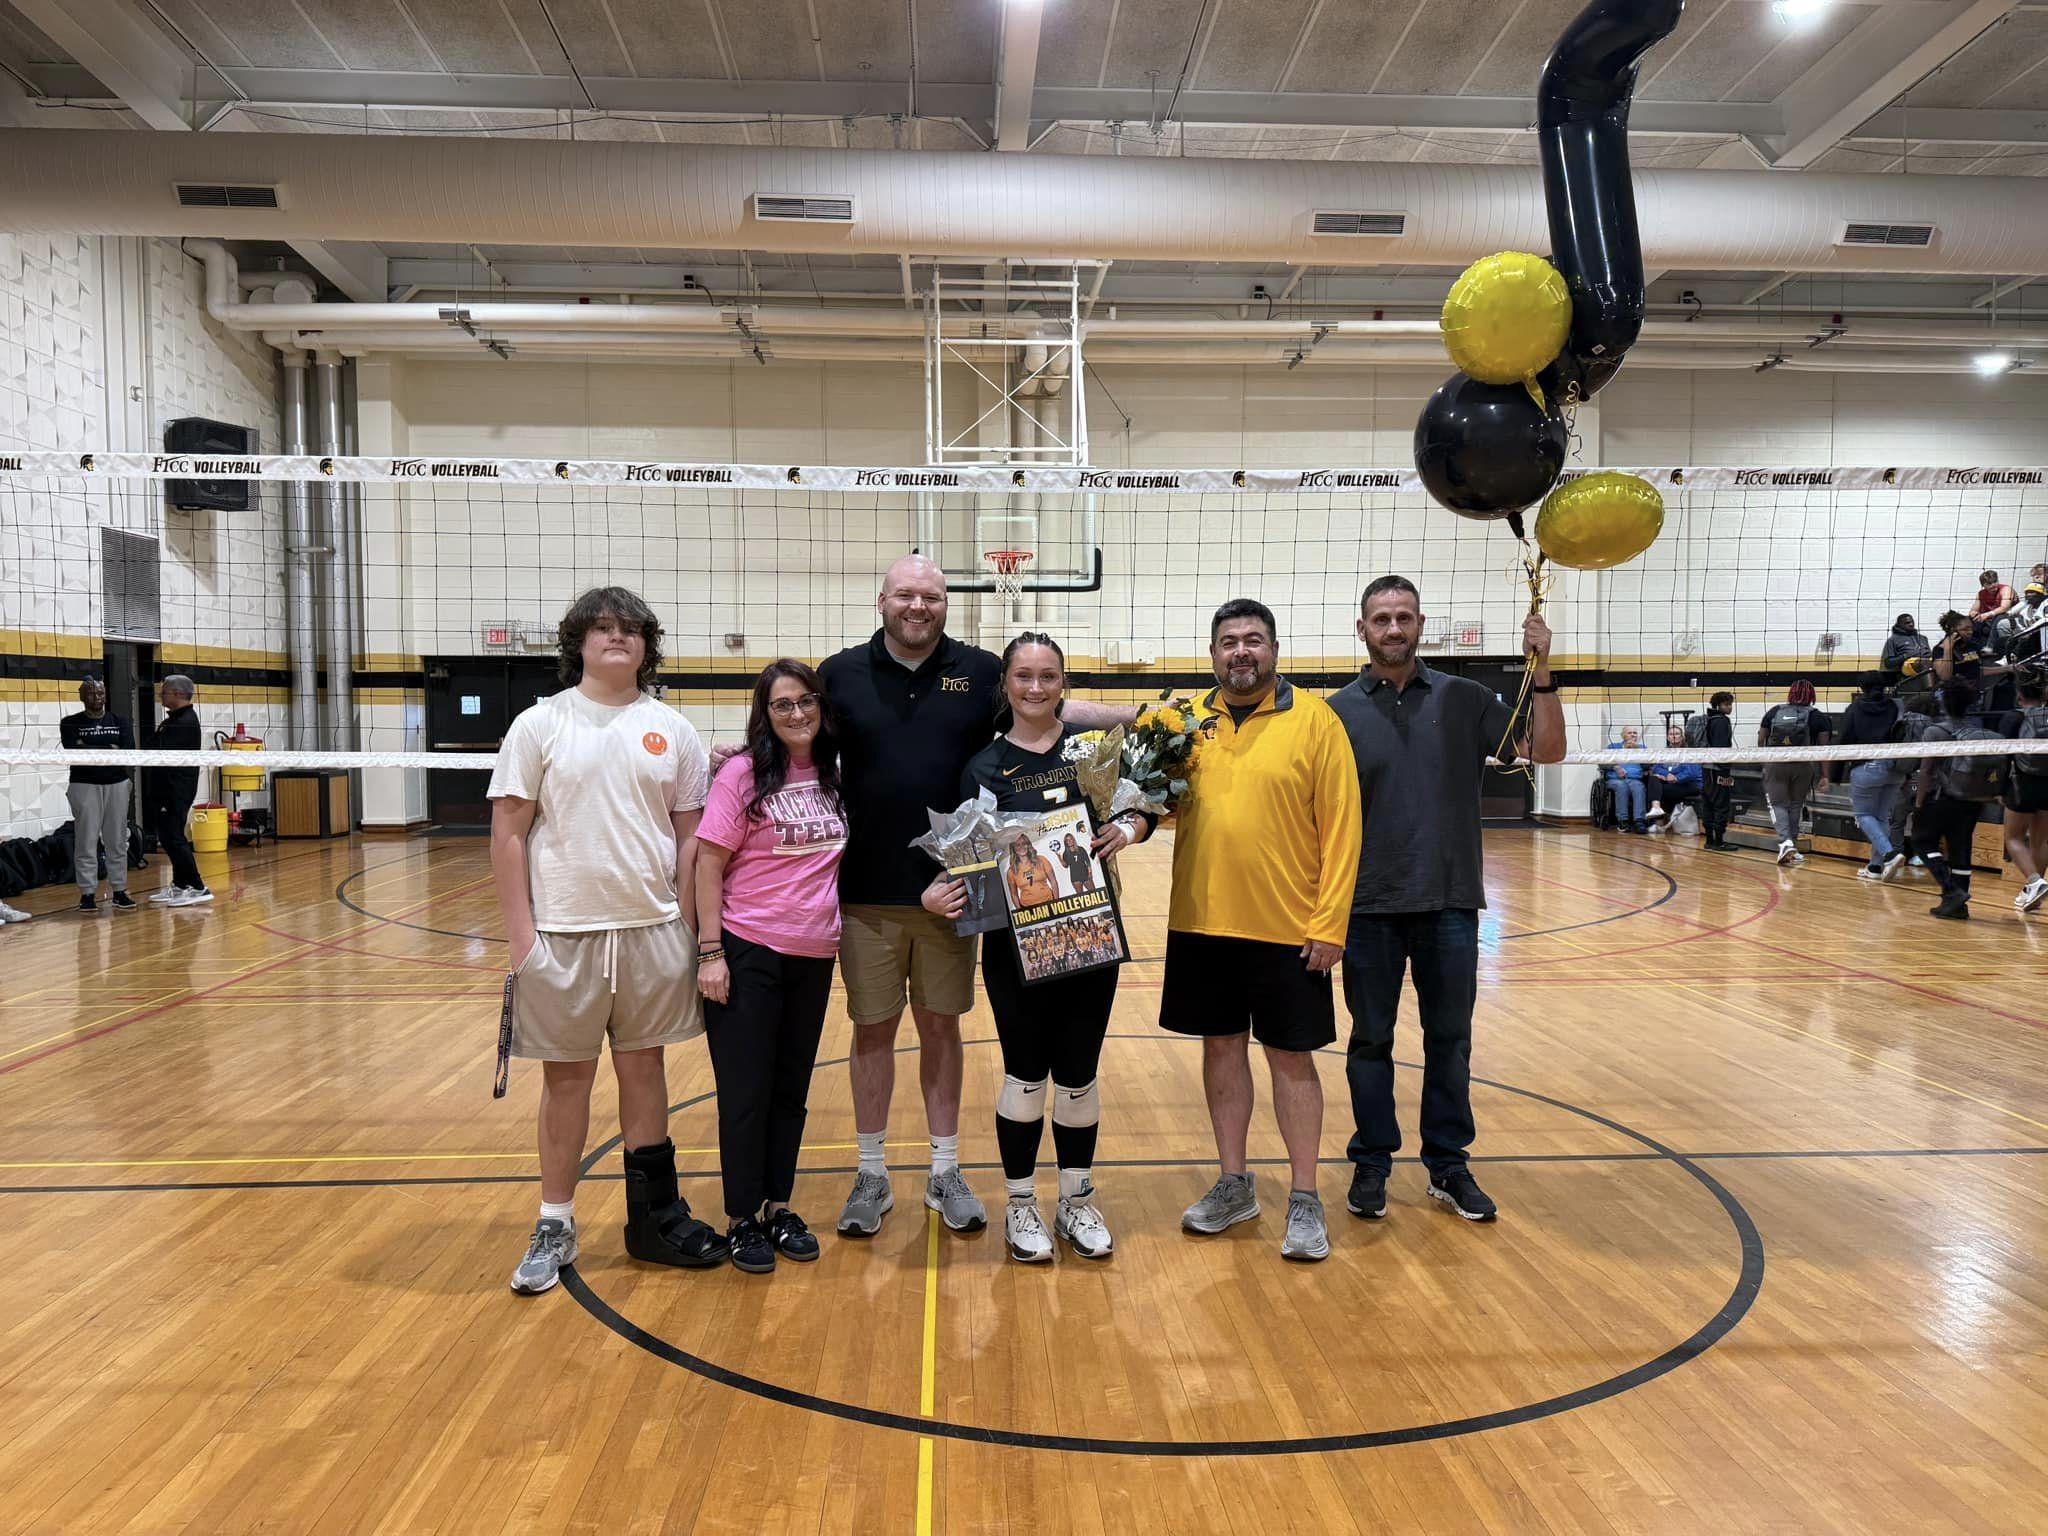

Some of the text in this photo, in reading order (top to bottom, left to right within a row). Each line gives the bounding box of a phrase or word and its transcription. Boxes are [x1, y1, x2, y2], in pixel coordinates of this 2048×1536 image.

[152, 455, 262, 474] FTCC VOLLEYBALL
[390, 459, 499, 477] FTCC VOLLEYBALL
[624, 464, 733, 483] FTCC VOLLEYBALL
[855, 469, 959, 486] FTCC VOLLEYBALL
[1078, 471, 1180, 488] FTCC VOLLEYBALL
[1298, 470, 1400, 487] FTCC VOLLEYBALL
[1734, 468, 1833, 485] FTCC VOLLEYBALL
[1945, 467, 2042, 485] FTCC VOLLEYBALL
[941, 677, 969, 691] FTCC
[1011, 766, 1078, 793] TROJAN
[1012, 891, 1109, 926] TROJAN VOLLEYBALL
